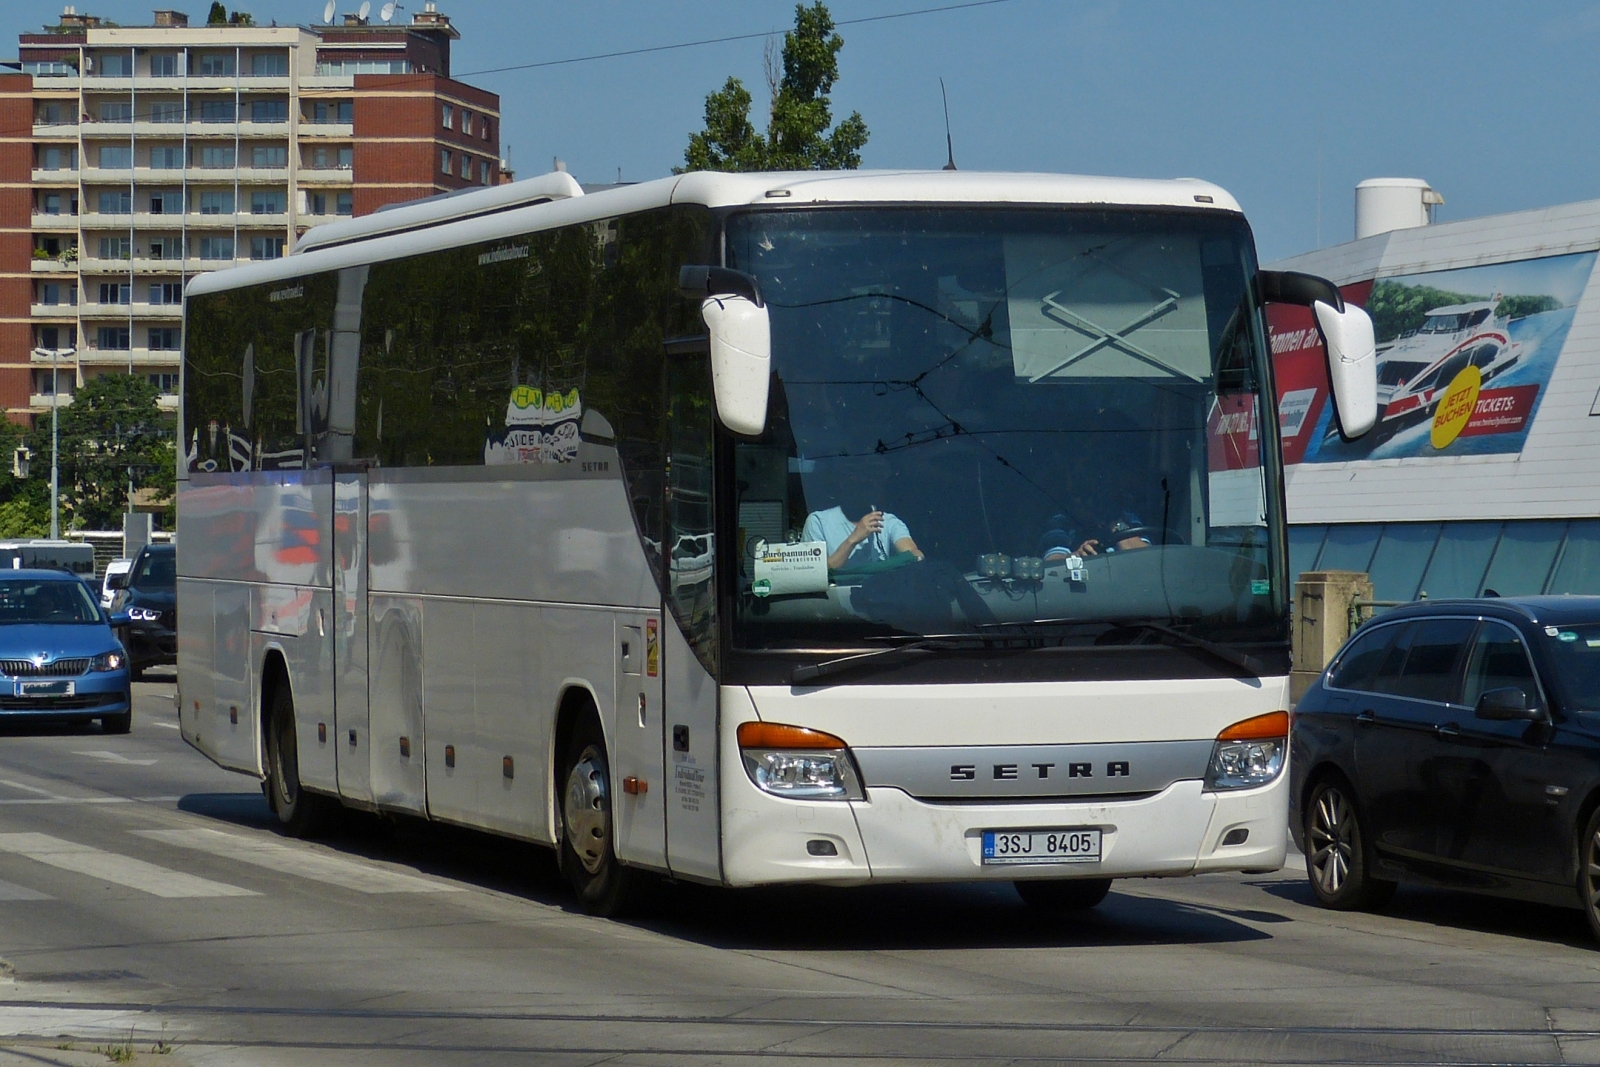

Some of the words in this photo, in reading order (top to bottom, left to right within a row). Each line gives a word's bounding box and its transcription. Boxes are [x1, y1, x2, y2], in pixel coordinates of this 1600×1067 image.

[1444, 385, 1474, 409] JETZT
[1474, 396, 1516, 414] TICKETS:
[1434, 401, 1473, 428] BUCHEN
[581, 461, 609, 472] SETRA
[762, 548, 822, 559] Europamundo
[950, 761, 1130, 781] SETRA
[999, 834, 1032, 853] 3SJ
[1047, 833, 1091, 853] 8405
